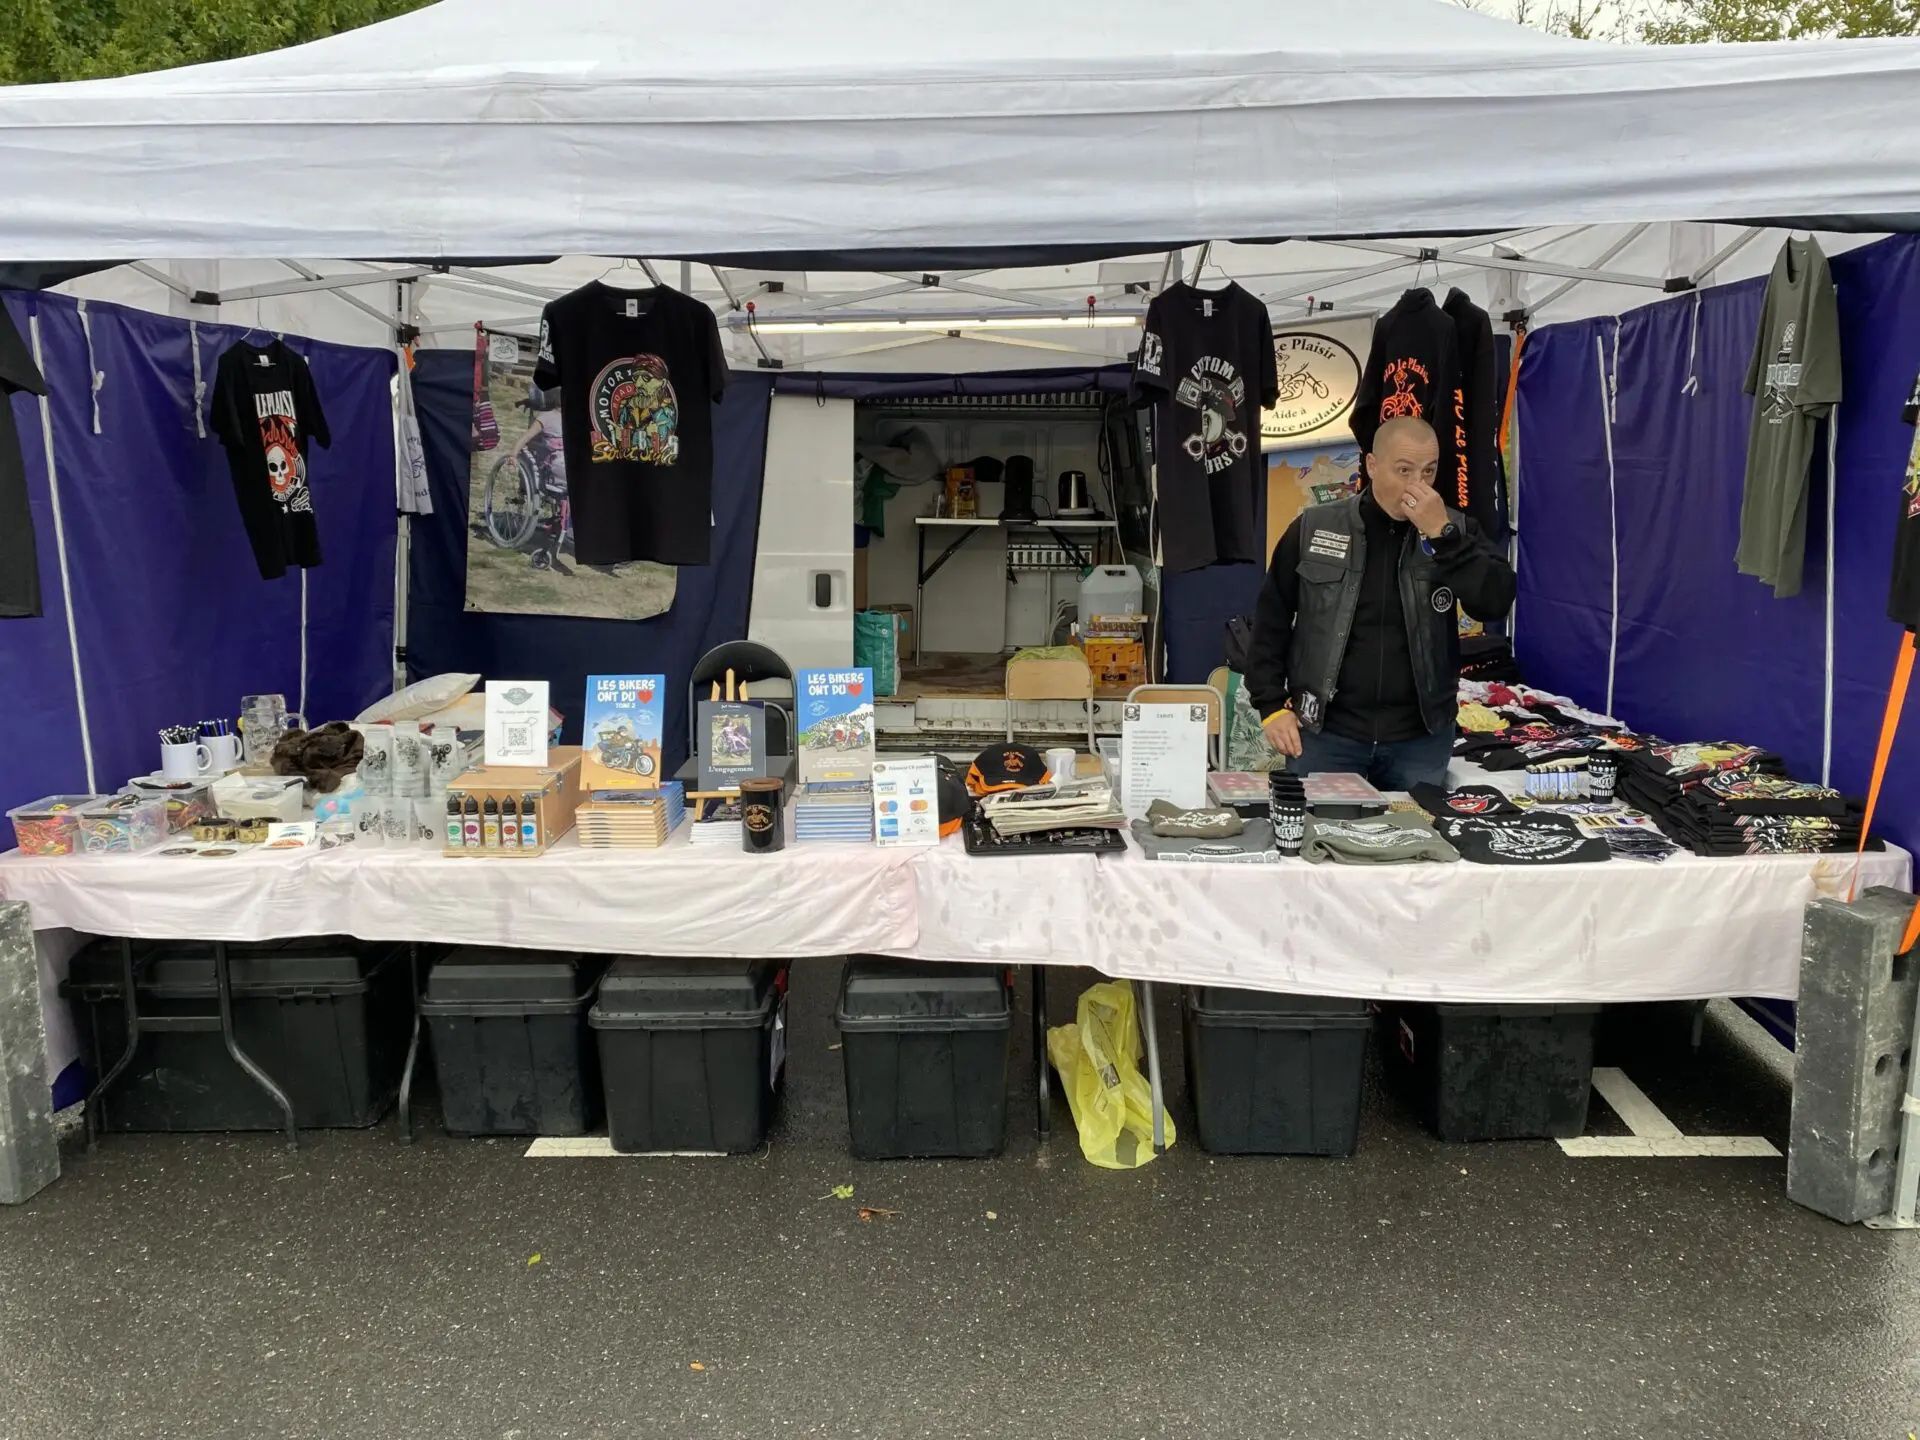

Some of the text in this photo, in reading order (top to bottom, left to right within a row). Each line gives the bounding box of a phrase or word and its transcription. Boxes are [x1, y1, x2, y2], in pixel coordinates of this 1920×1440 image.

[1292, 339, 1336, 360] Plaisir
[599, 370, 624, 418] MOTOR
[1272, 407, 1308, 420] Aide à
[1300, 398, 1345, 429] malade
[807, 672, 865, 684] LES BIKERS
[597, 679, 656, 690] LES BIKERS
[808, 685, 847, 696] ONT DU
[597, 691, 636, 702] ONT DU
